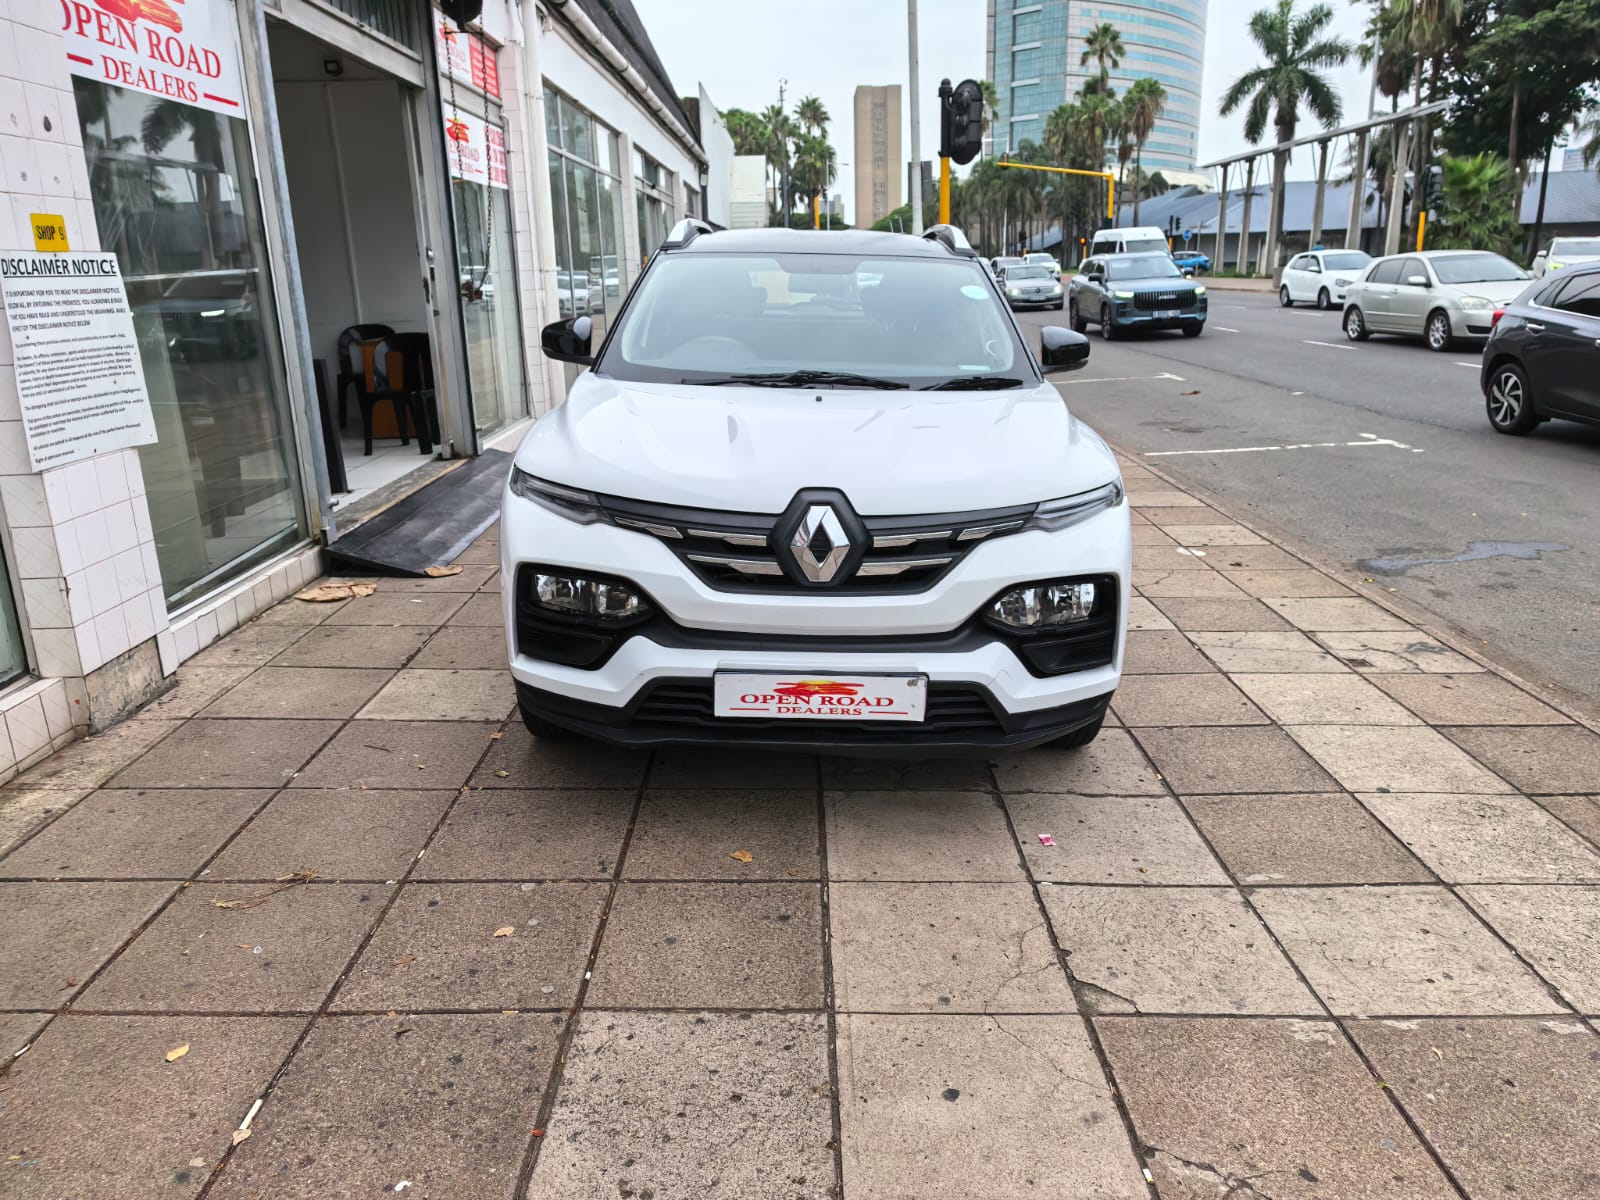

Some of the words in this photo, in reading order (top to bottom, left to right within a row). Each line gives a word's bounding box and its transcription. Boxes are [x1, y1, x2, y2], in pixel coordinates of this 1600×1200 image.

[144, 26, 222, 79] ROAD
[100, 54, 199, 102] DEALERS
[36, 225, 55, 240] SHOP
[58, 227, 65, 240] 9
[1, 259, 70, 275] DISCLAIMER
[72, 259, 117, 274] NOTICE
[740, 693, 810, 705] OPEN
[819, 696, 894, 707] ROAD
[777, 706, 862, 716] DEALERS
